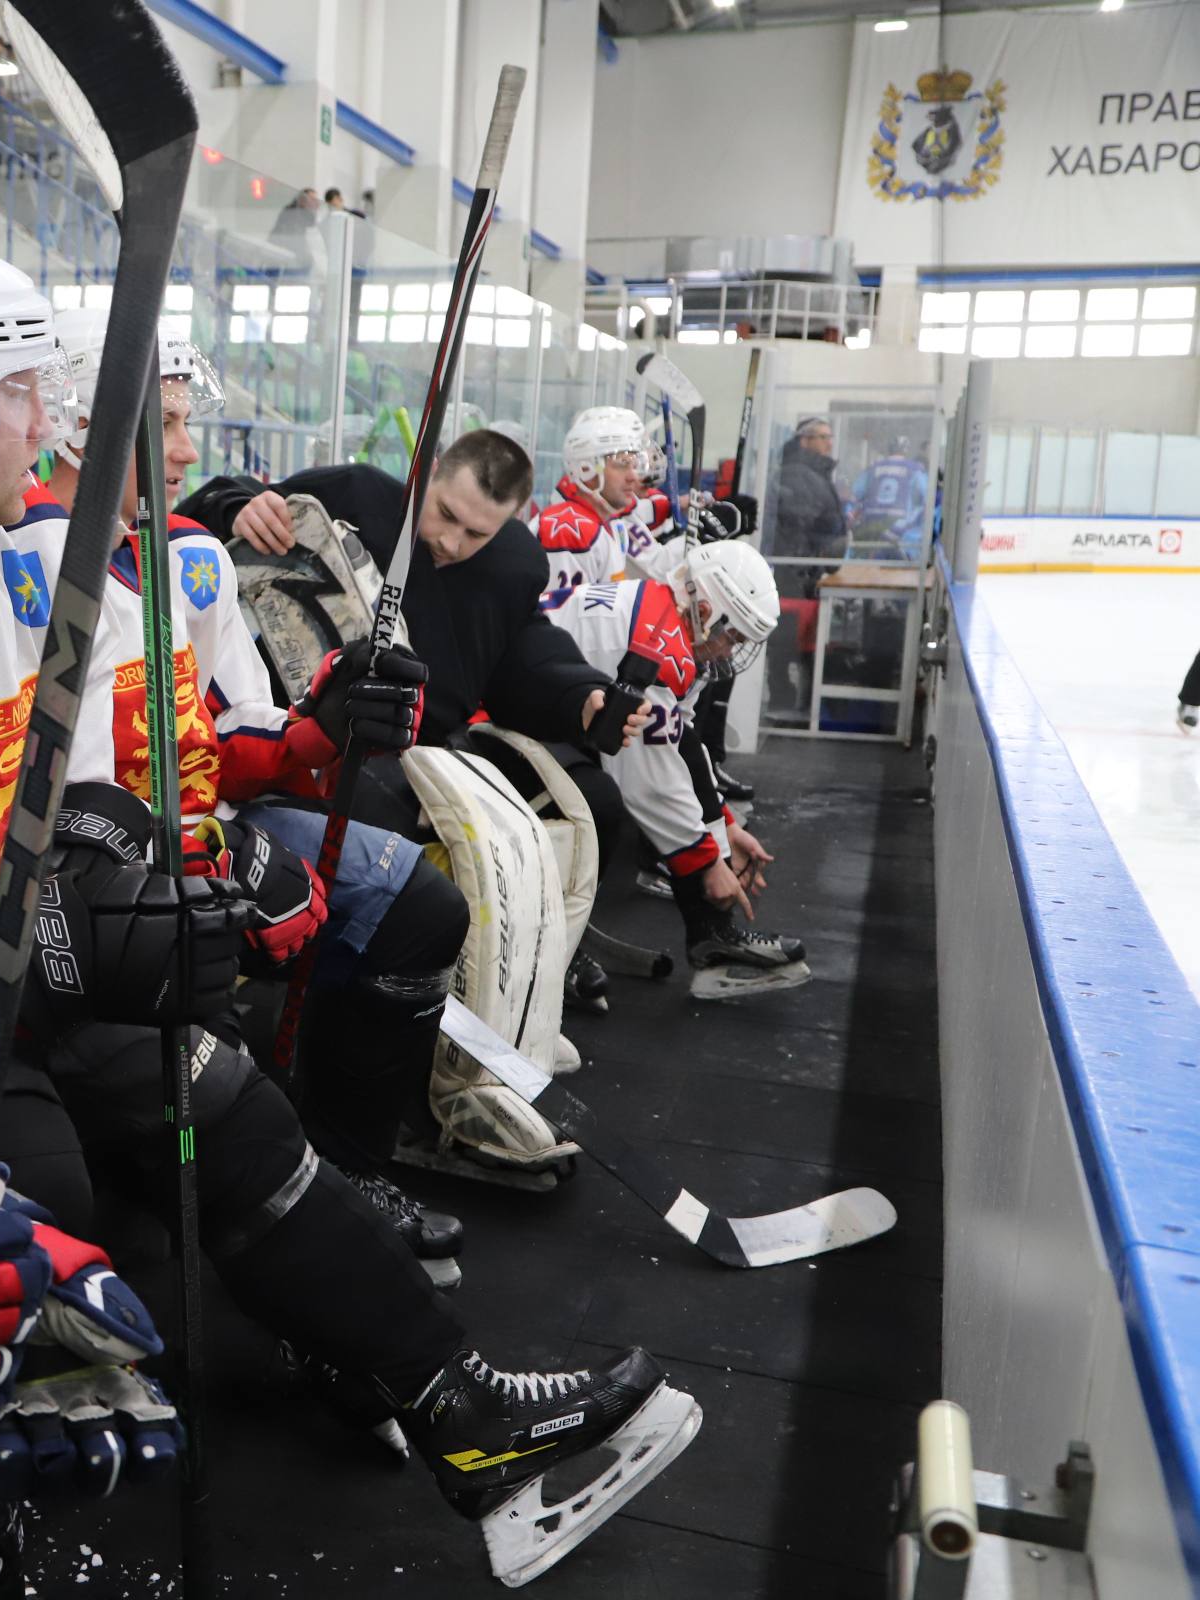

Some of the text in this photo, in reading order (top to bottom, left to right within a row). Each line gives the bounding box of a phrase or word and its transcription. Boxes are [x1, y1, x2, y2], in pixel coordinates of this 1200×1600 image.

[1099, 89, 1200, 125] ПРАВ
[1047, 141, 1200, 177] ХАБАРО
[1071, 533, 1153, 547] АРМАТА
[371, 584, 401, 650] REKK
[643, 704, 683, 746] 23
